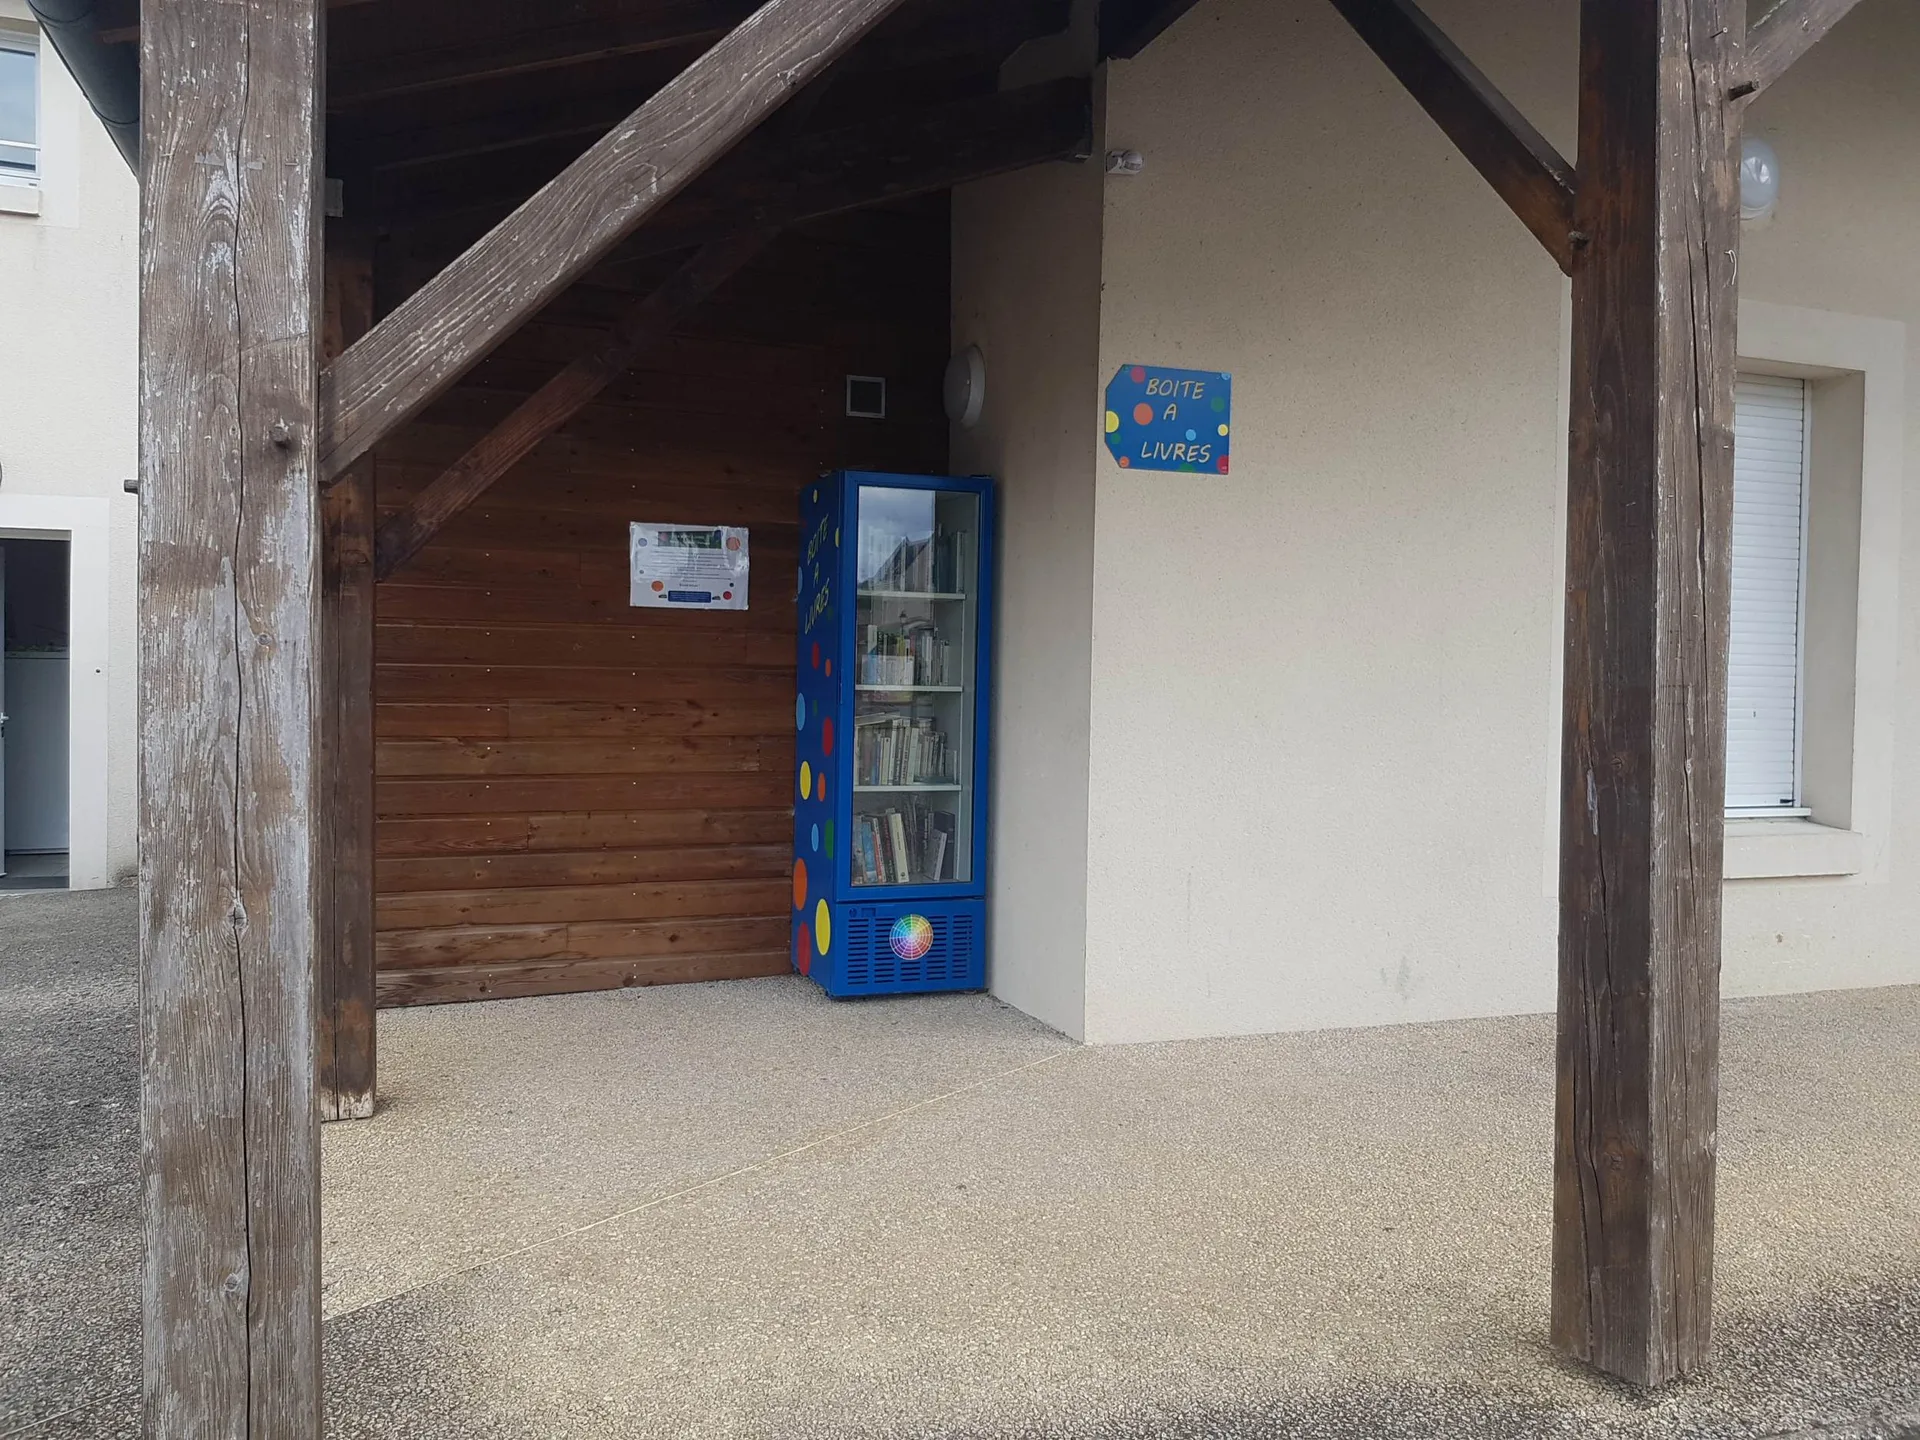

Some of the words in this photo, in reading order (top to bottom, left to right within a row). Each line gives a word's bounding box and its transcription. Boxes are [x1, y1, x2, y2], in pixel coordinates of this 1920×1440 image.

[1146, 378, 1205, 399] BOITE
[1163, 403, 1177, 421] A
[1141, 441, 1211, 463] LIVRES
[813, 562, 819, 588] A
[804, 577, 830, 635] LIVRES
